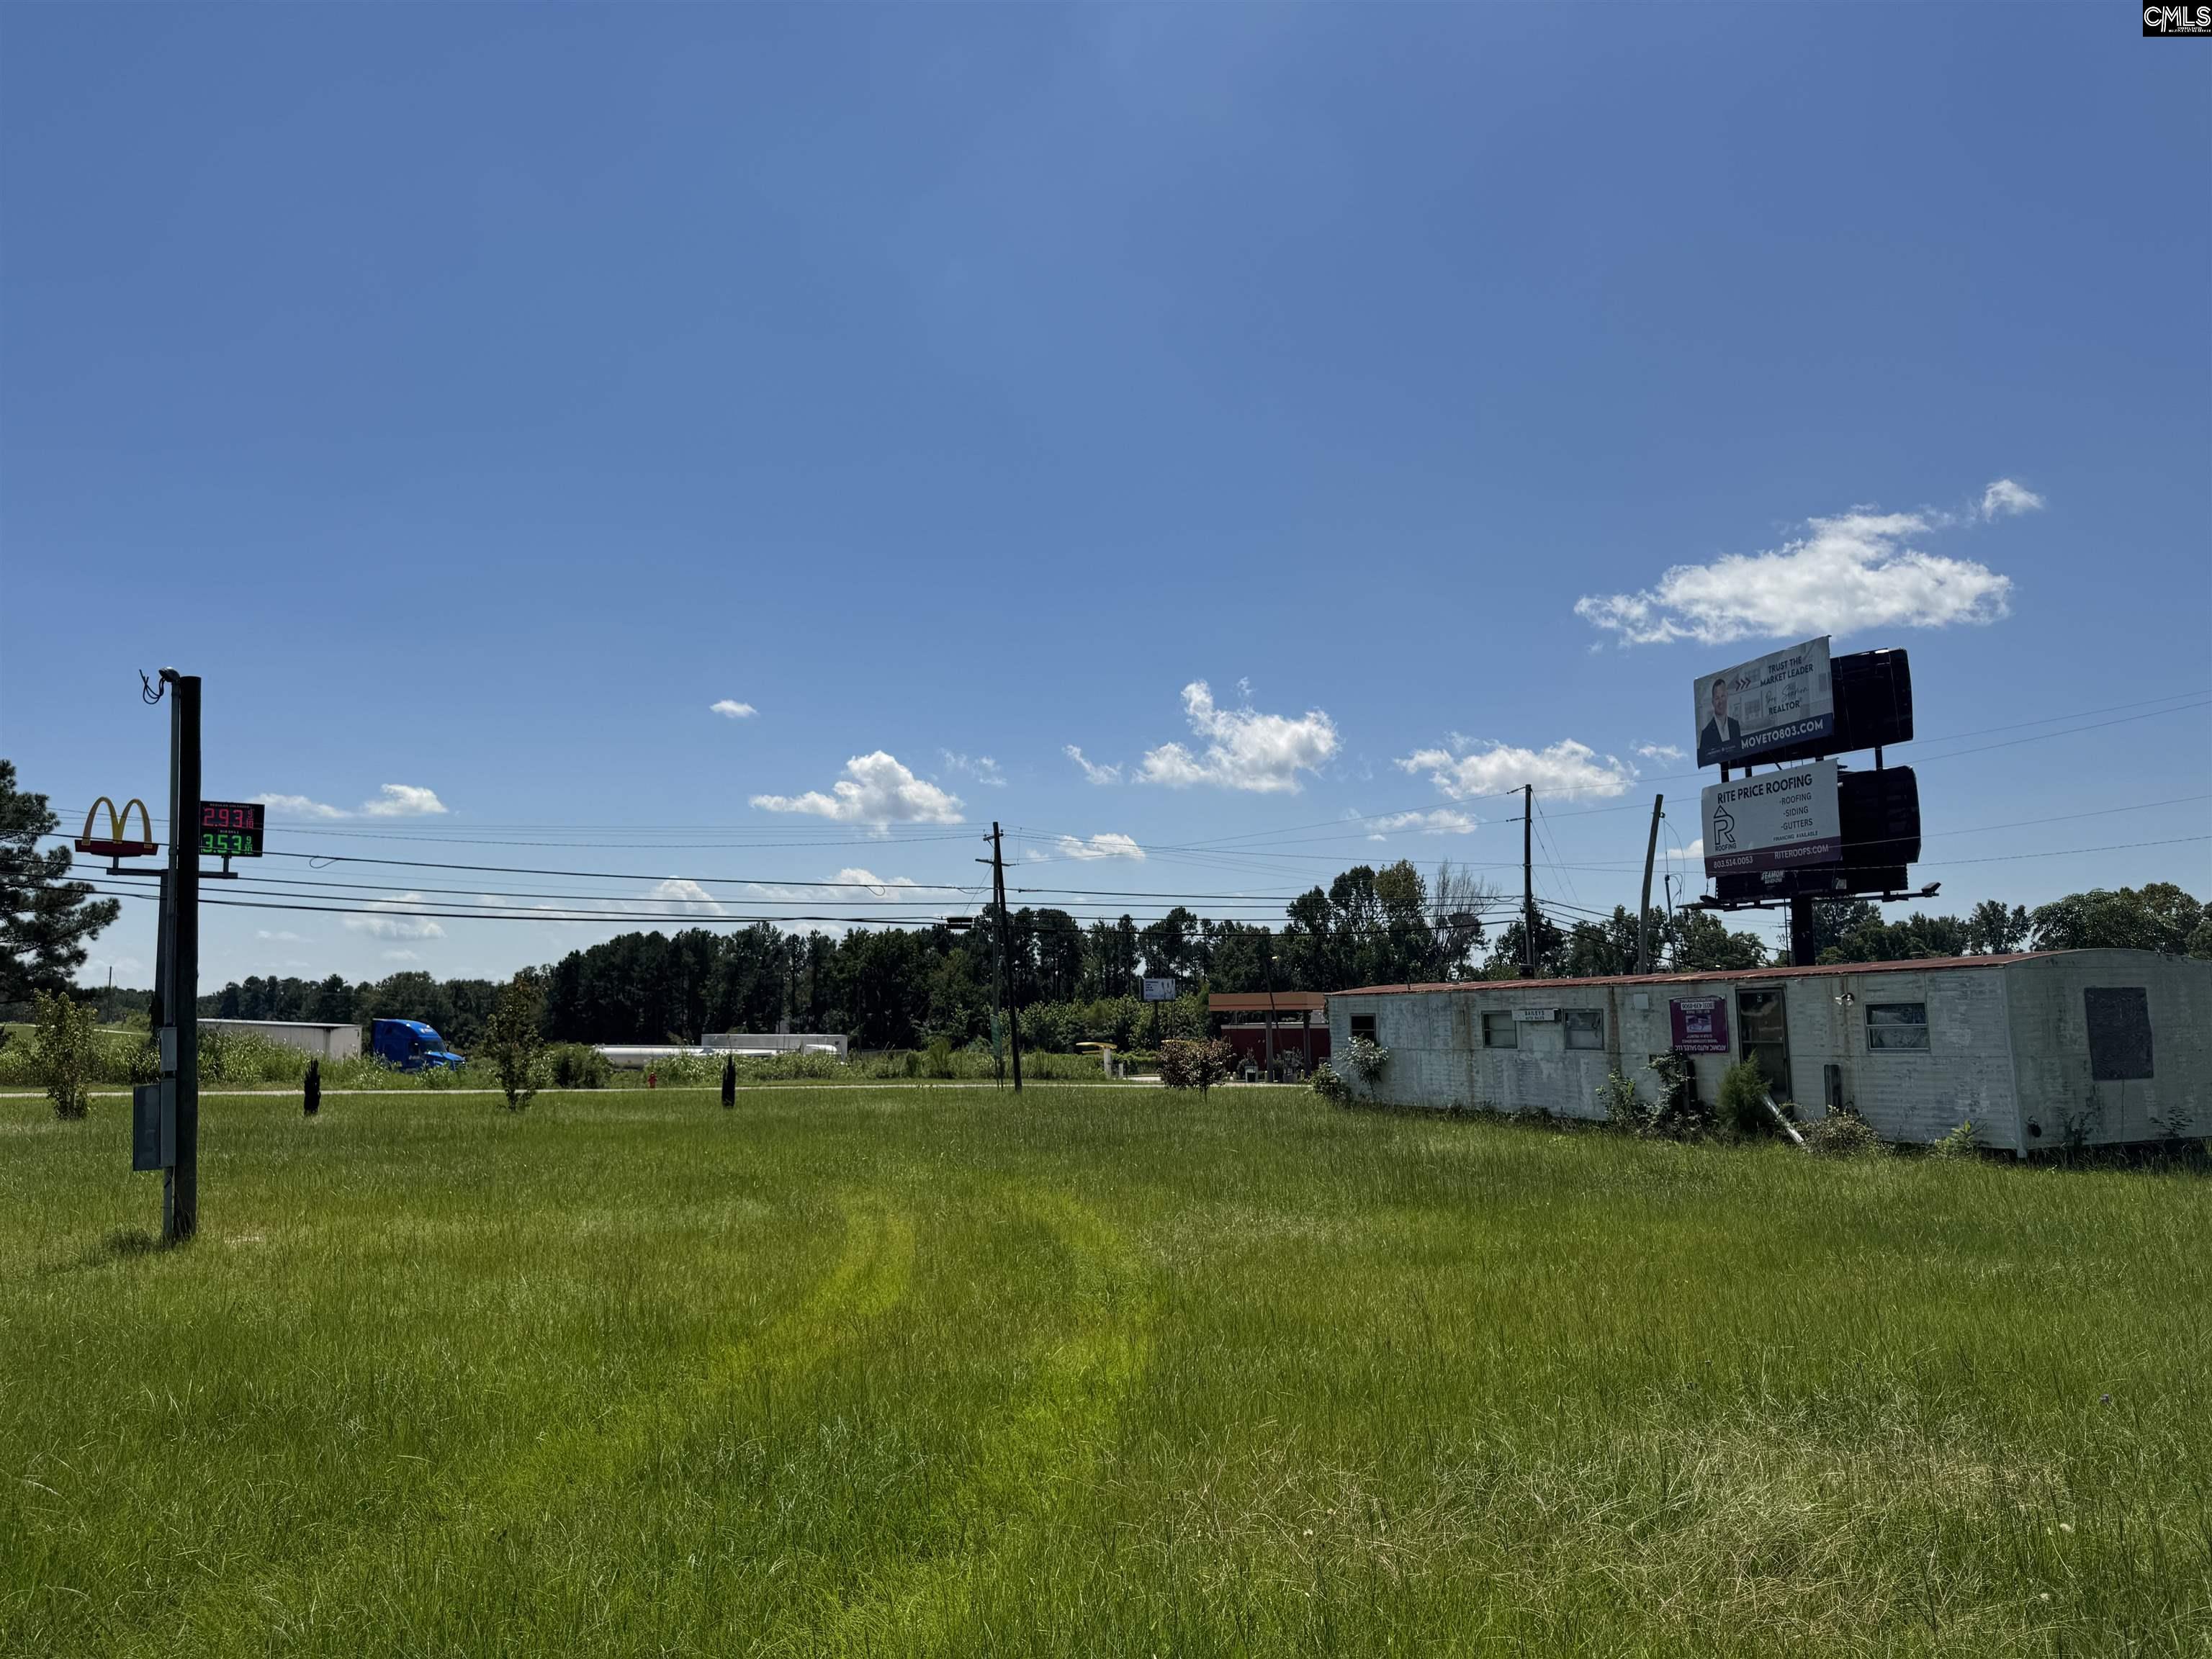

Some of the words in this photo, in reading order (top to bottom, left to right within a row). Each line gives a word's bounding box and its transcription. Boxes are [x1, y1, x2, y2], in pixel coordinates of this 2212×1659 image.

[1768, 660, 1788, 674] TRUST
[1789, 656, 1802, 666] THE
[1760, 673, 1786, 686] MARKET
[1788, 664, 1814, 678] LEADER
[1741, 719, 1823, 750] MOVETO803.COM
[1717, 790, 1736, 804] RITE
[1738, 784, 1764, 800] PRICE
[1766, 773, 1813, 794] ROOFING
[1773, 833, 1794, 842] FINANCING
[1715, 842, 1737, 852] ROOFING
[1774, 844, 1829, 860] RITEROOFS.COM
[1713, 855, 1753, 869] 803.514.0053
